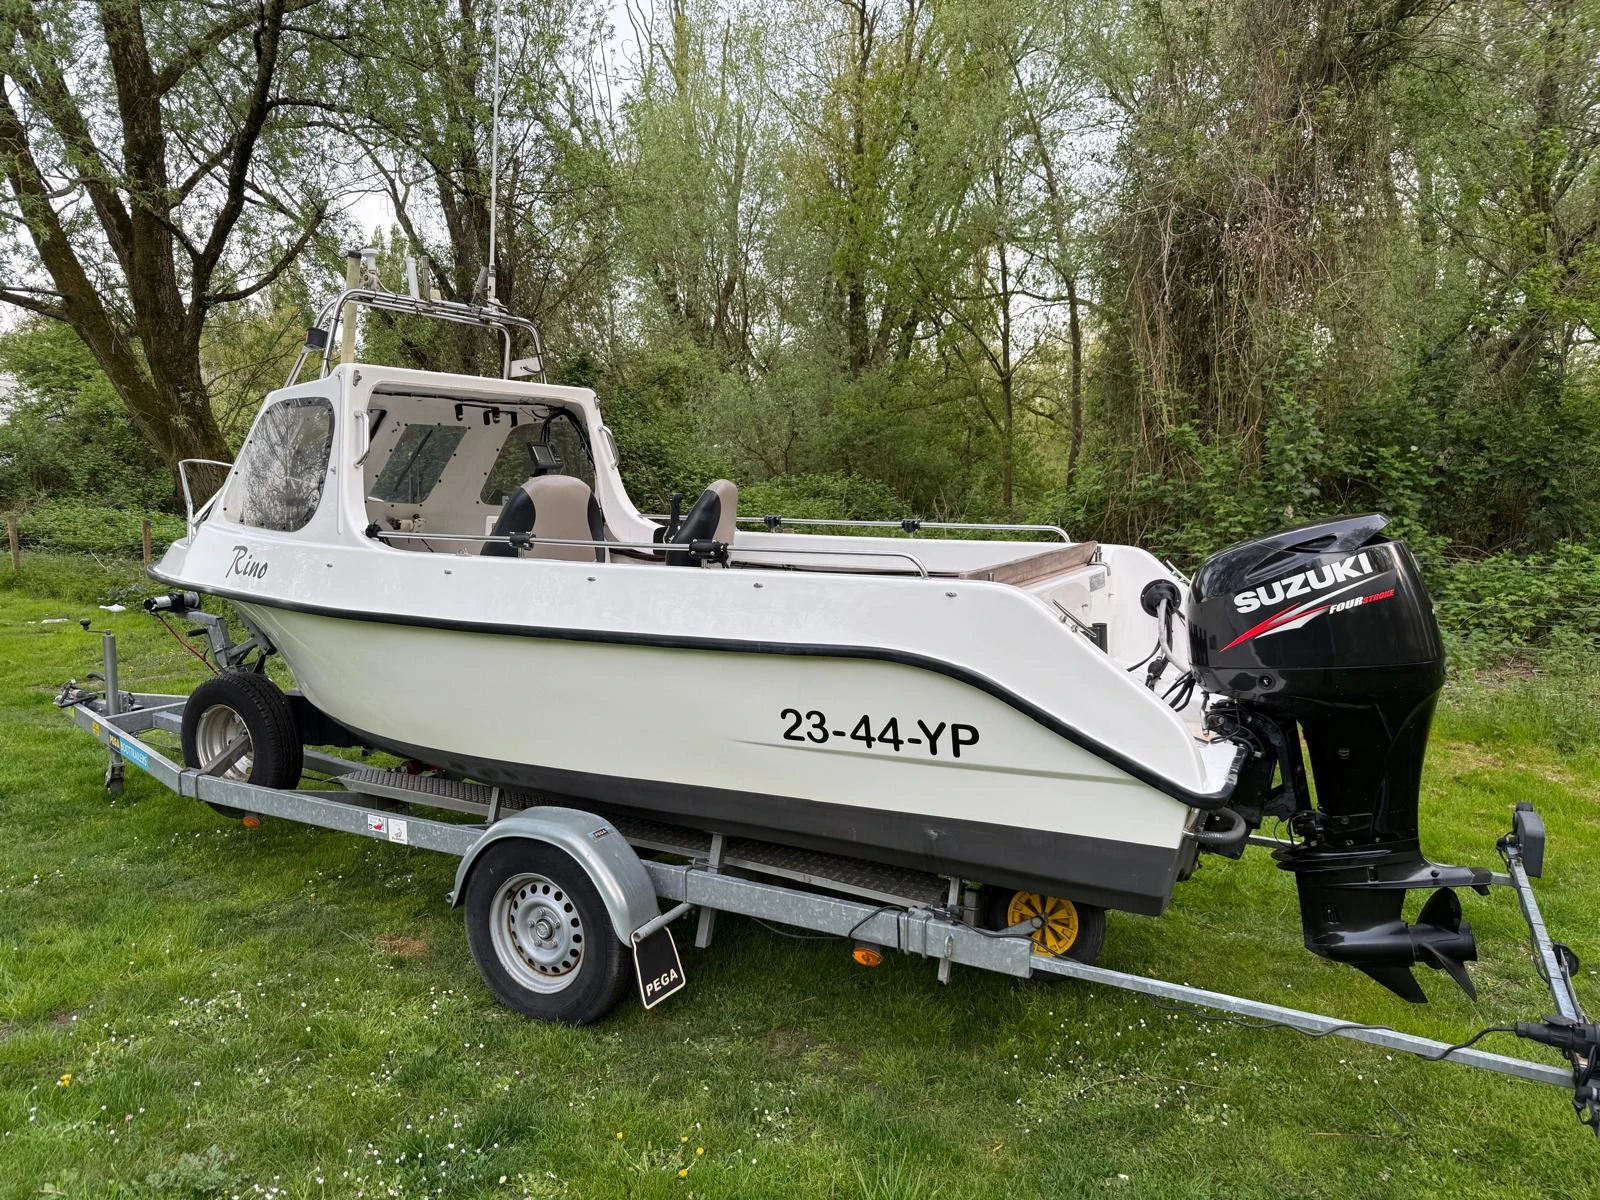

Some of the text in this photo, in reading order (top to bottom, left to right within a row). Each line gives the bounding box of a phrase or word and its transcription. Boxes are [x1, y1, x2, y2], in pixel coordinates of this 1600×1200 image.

[225, 545, 268, 579] Rino
[1233, 552, 1373, 614] SUZUKI
[780, 708, 980, 758] 23-44-YP
[645, 967, 678, 997] PEGA
